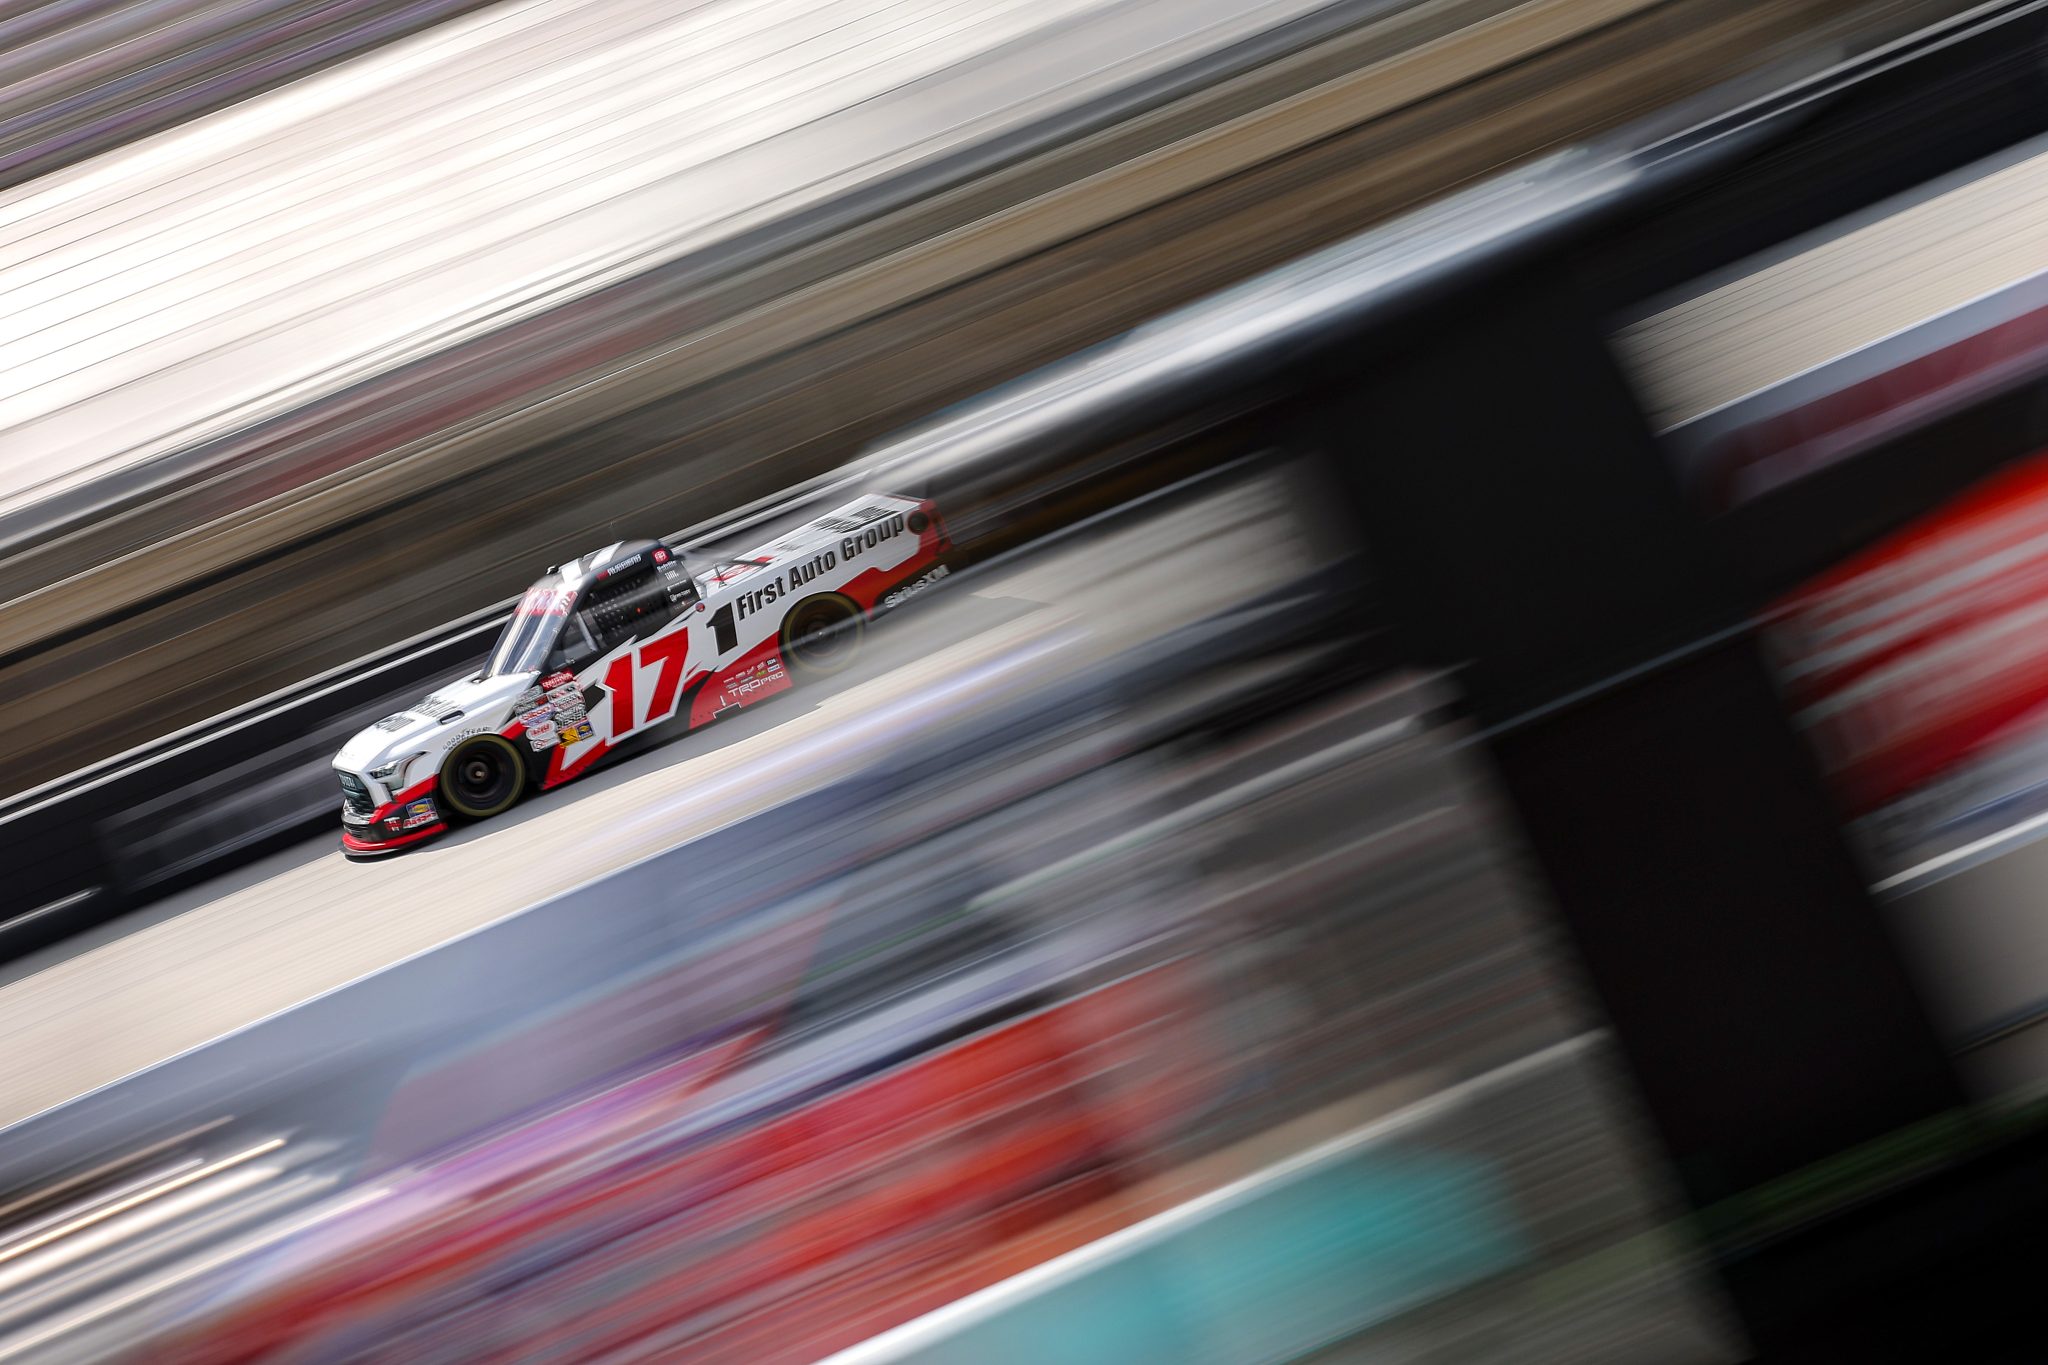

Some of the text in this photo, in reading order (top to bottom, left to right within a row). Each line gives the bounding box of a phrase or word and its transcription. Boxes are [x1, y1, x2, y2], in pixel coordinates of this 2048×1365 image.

[706, 602, 738, 656] 1
[735, 576, 786, 621] First
[788, 549, 837, 592] Auto
[839, 513, 904, 562] Group
[603, 626, 689, 738] 17
